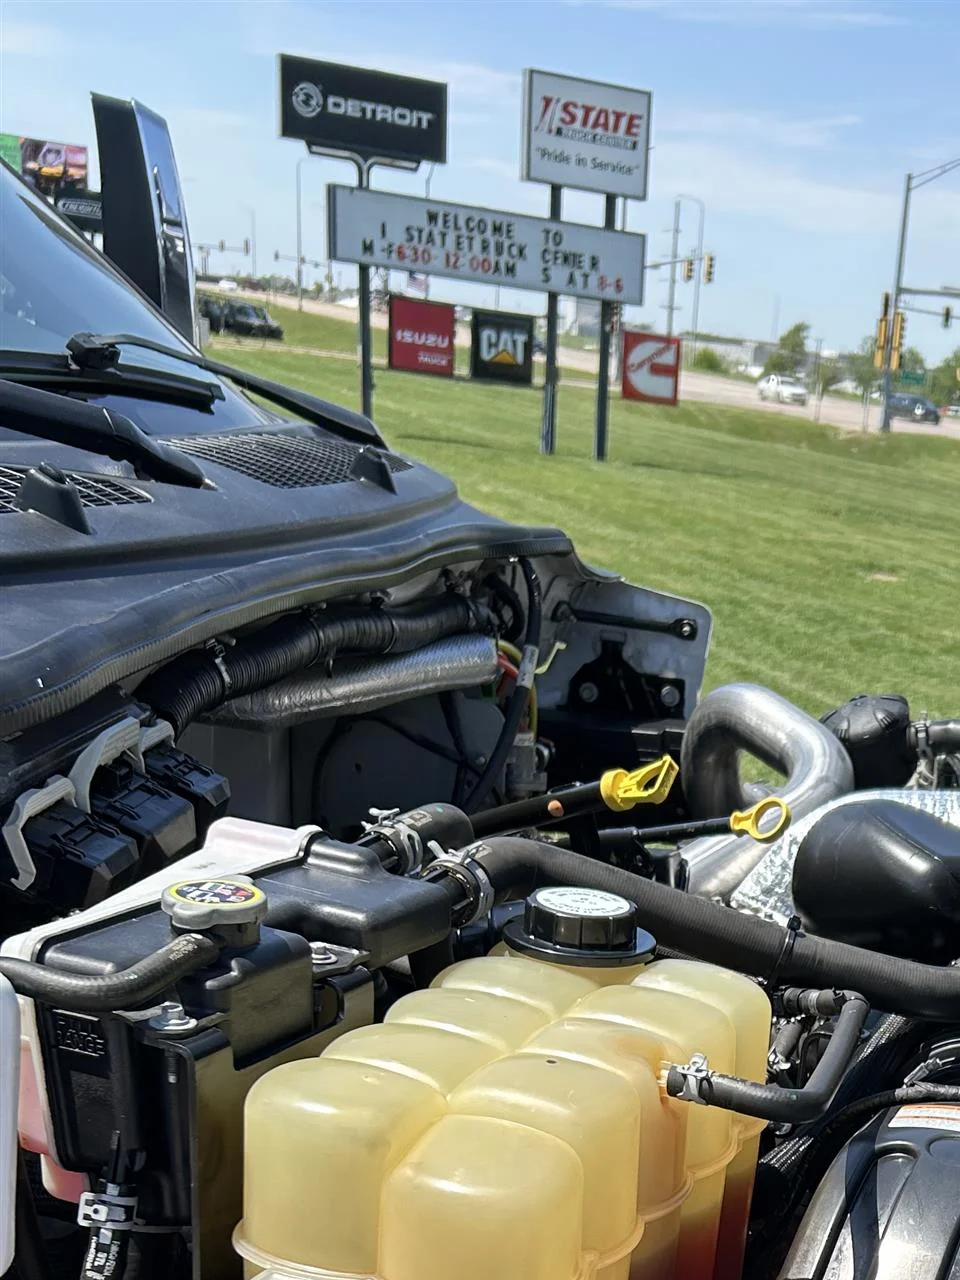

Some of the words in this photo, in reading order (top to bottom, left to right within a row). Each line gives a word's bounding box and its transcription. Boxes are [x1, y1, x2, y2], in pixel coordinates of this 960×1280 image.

[326, 94, 433, 129] DETROIT
[560, 100, 644, 137] STATE
[575, 152, 588, 168] in
[426, 208, 515, 240] WELCOME
[541, 227, 563, 247] TO
[541, 247, 600, 273] CENTER
[396, 329, 449, 348] ISUZU
[481, 327, 528, 365] CAT
